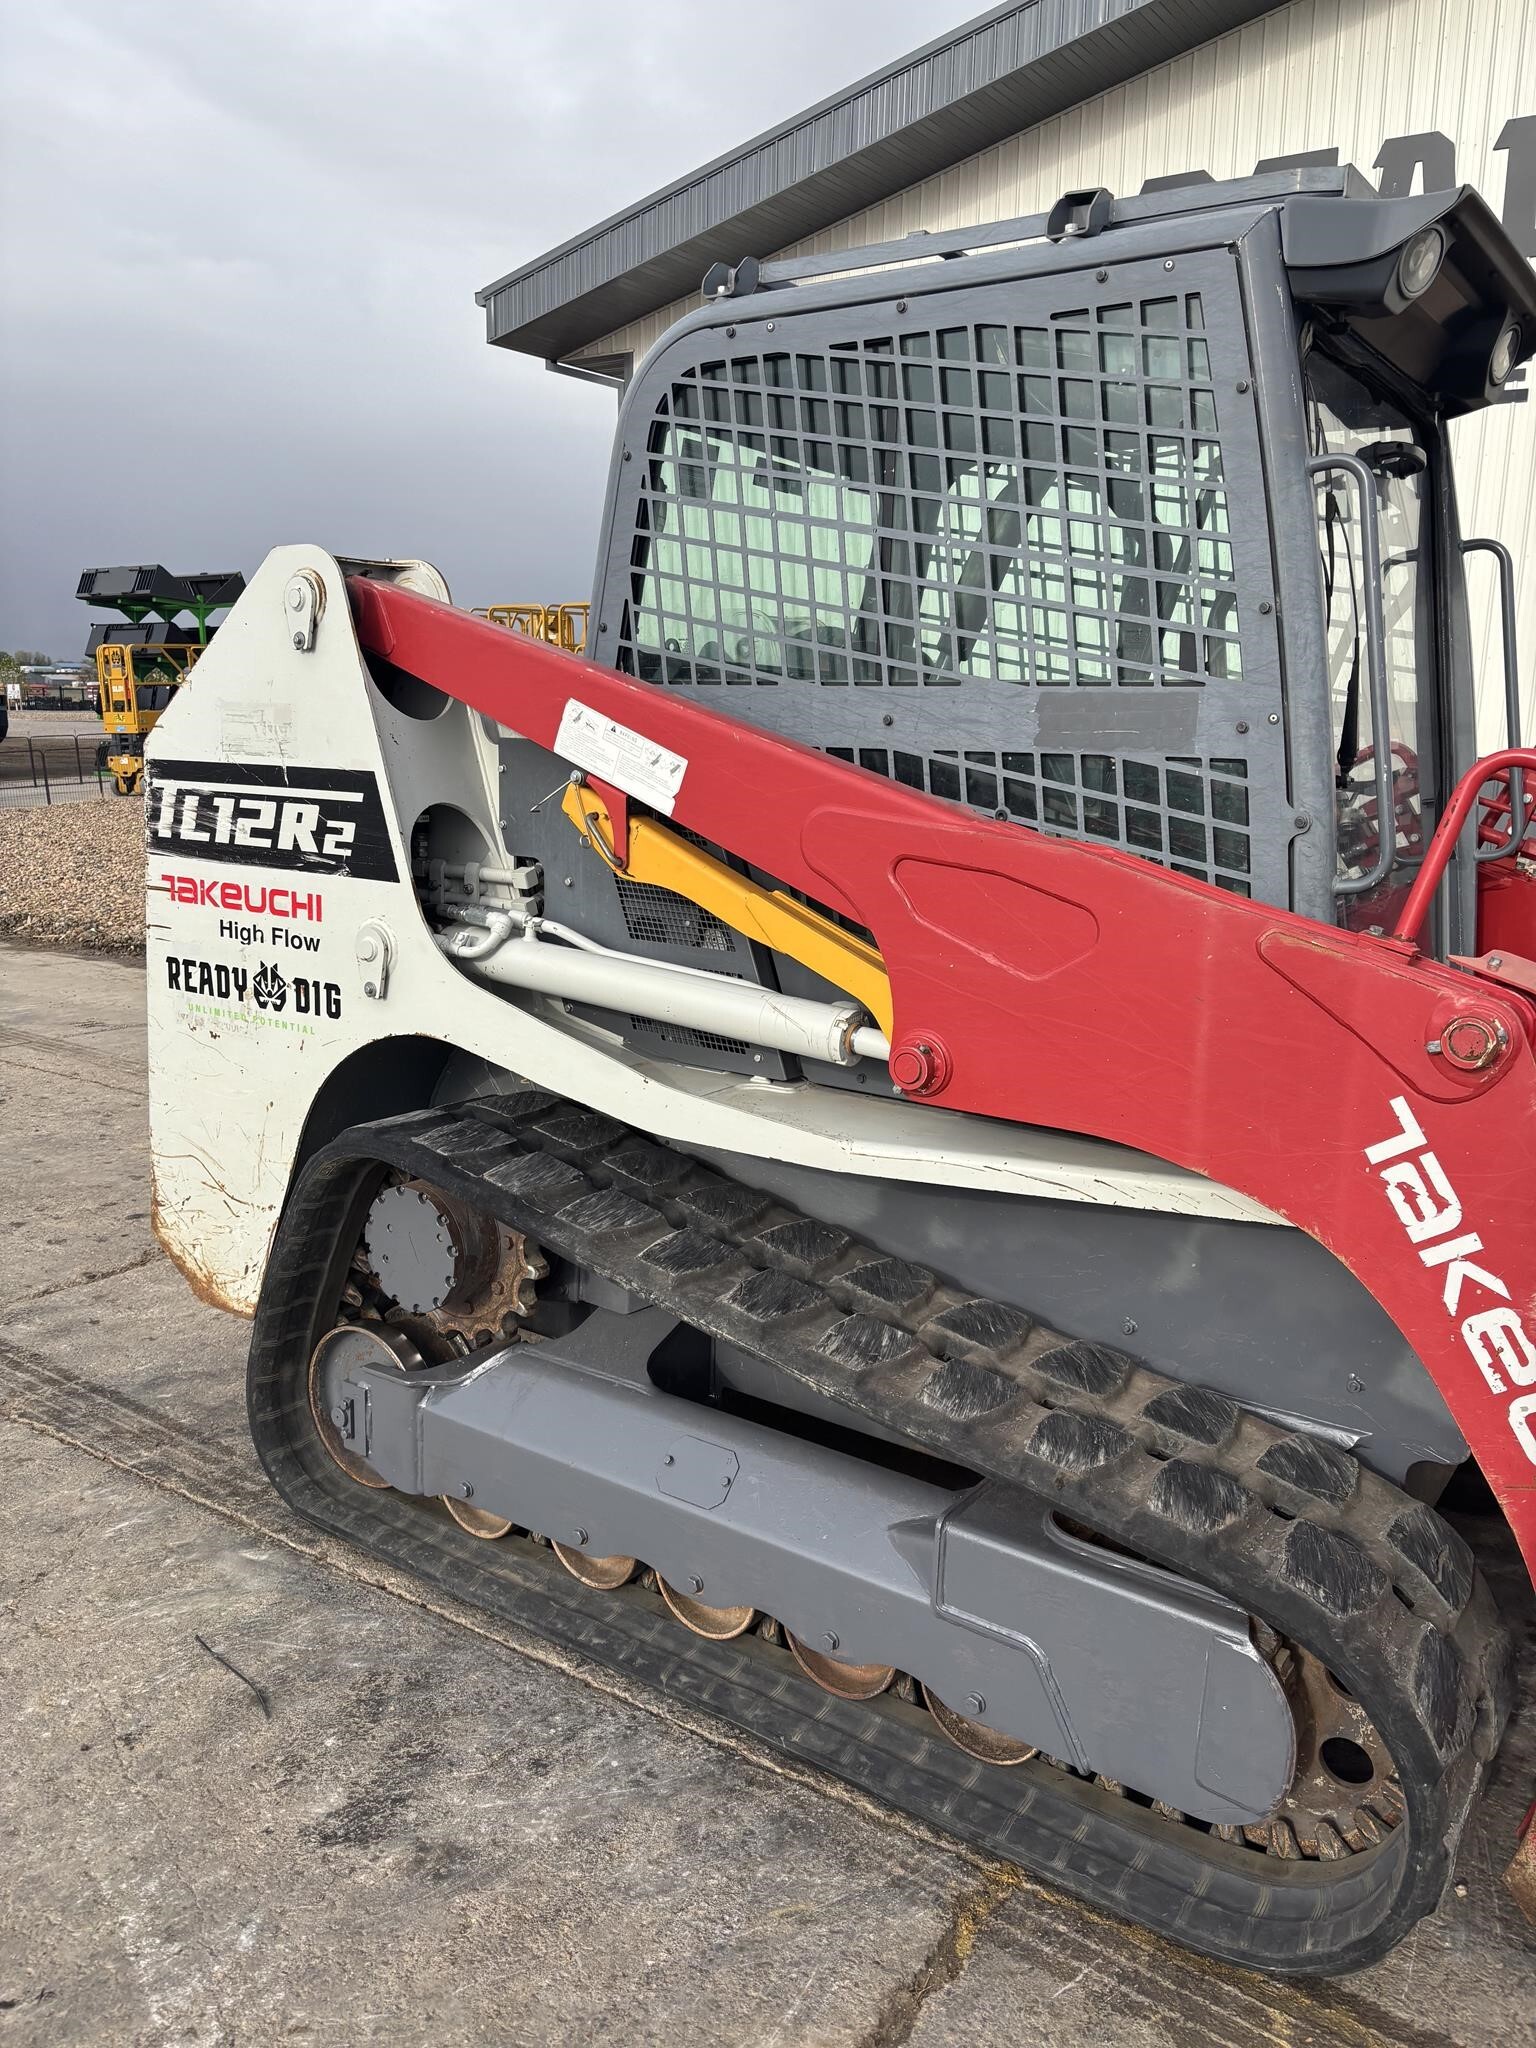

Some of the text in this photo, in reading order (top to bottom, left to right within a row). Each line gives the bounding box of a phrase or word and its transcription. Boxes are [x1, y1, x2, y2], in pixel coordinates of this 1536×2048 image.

[153, 780, 356, 856] TL12R2
[219, 919, 321, 952] High Flow
[166, 956, 342, 1019] READY DIG
[187, 1002, 247, 1022] UNLIMITED
[252, 1016, 316, 1035] POTENTIAL
